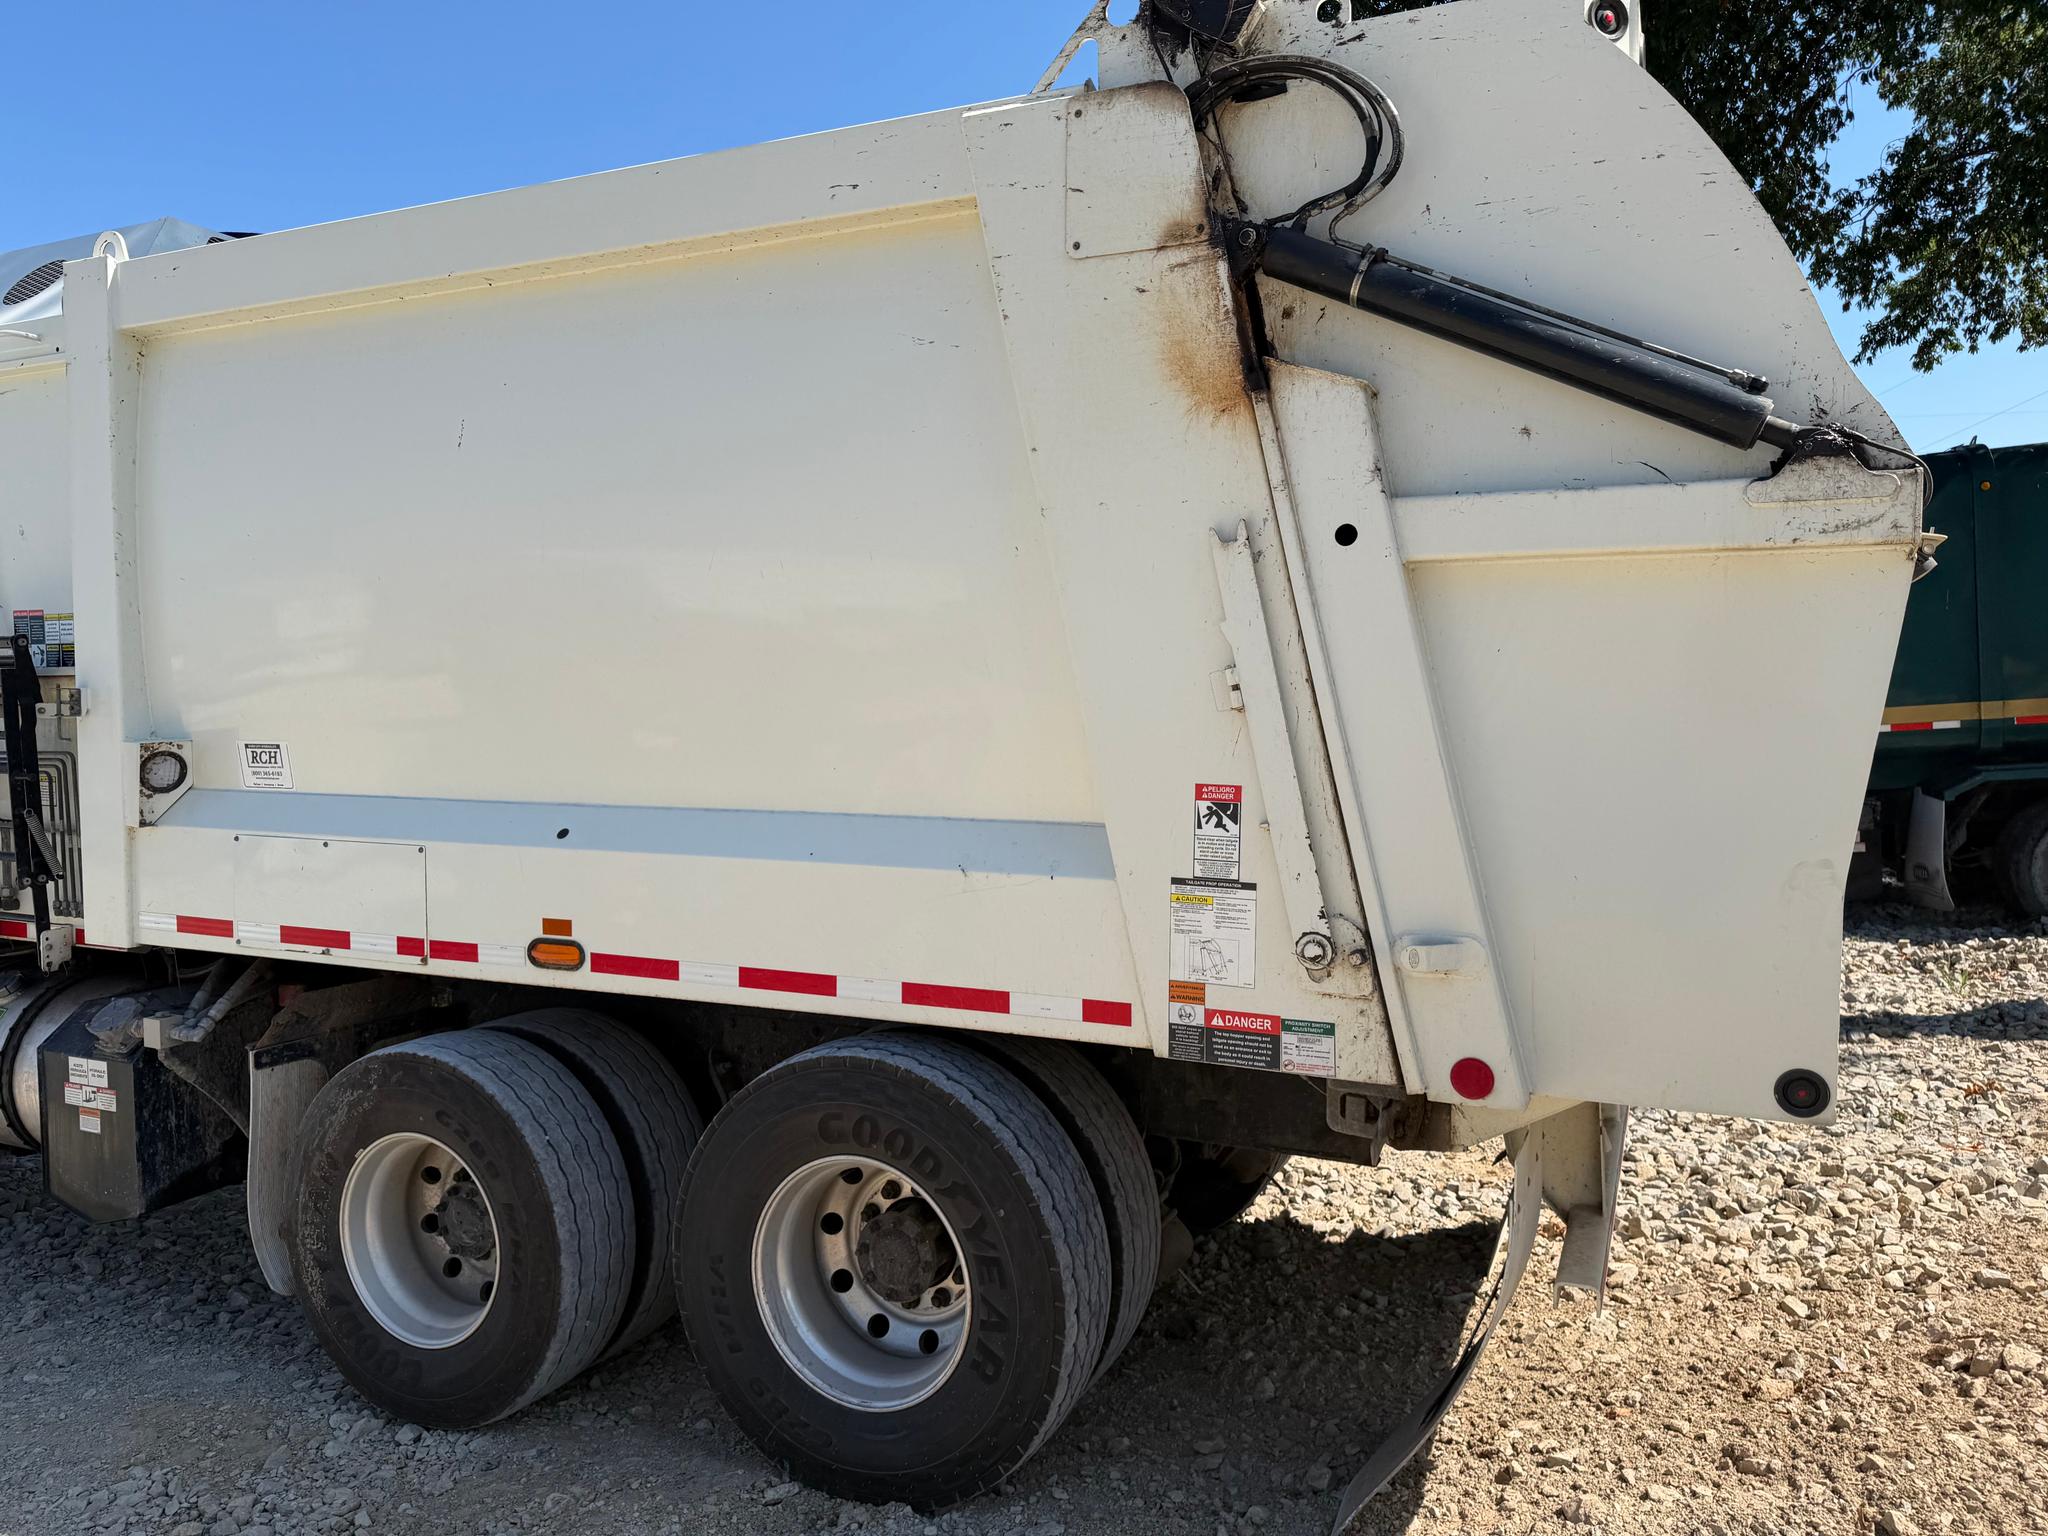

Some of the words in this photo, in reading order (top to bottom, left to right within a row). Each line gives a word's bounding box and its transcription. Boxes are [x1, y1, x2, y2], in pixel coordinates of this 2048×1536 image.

[250, 750, 278, 764] RCH
[1225, 1015, 1272, 1030] DANGER
[816, 1110, 1010, 1386] GOODYEAR
